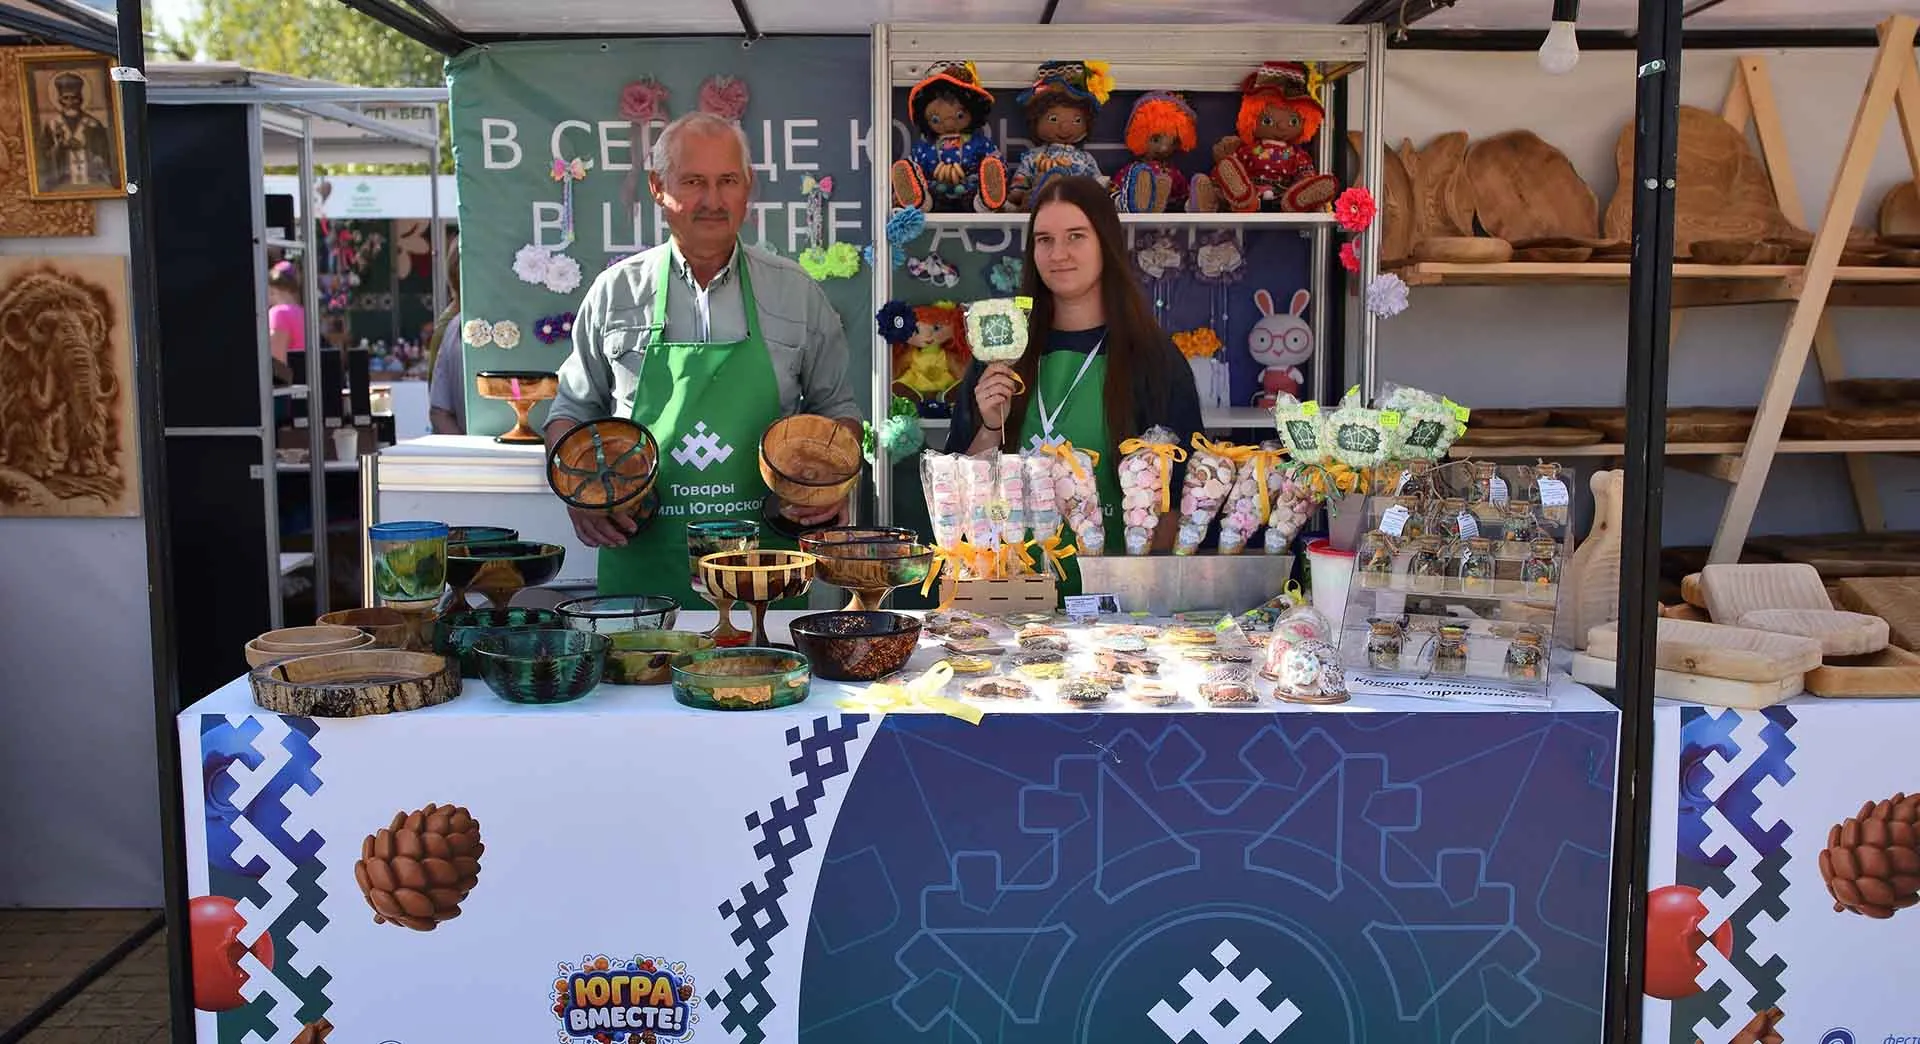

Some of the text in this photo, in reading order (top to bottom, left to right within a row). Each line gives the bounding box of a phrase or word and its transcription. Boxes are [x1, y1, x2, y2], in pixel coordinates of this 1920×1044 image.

[482, 118, 523, 170] В
[532, 201, 575, 252] В
[670, 483, 735, 497] Товары
[689, 498, 764, 516] Югорско
[574, 975, 674, 1007] ЮГРА
[569, 1006, 684, 1032] ВМЕСТЕ!
